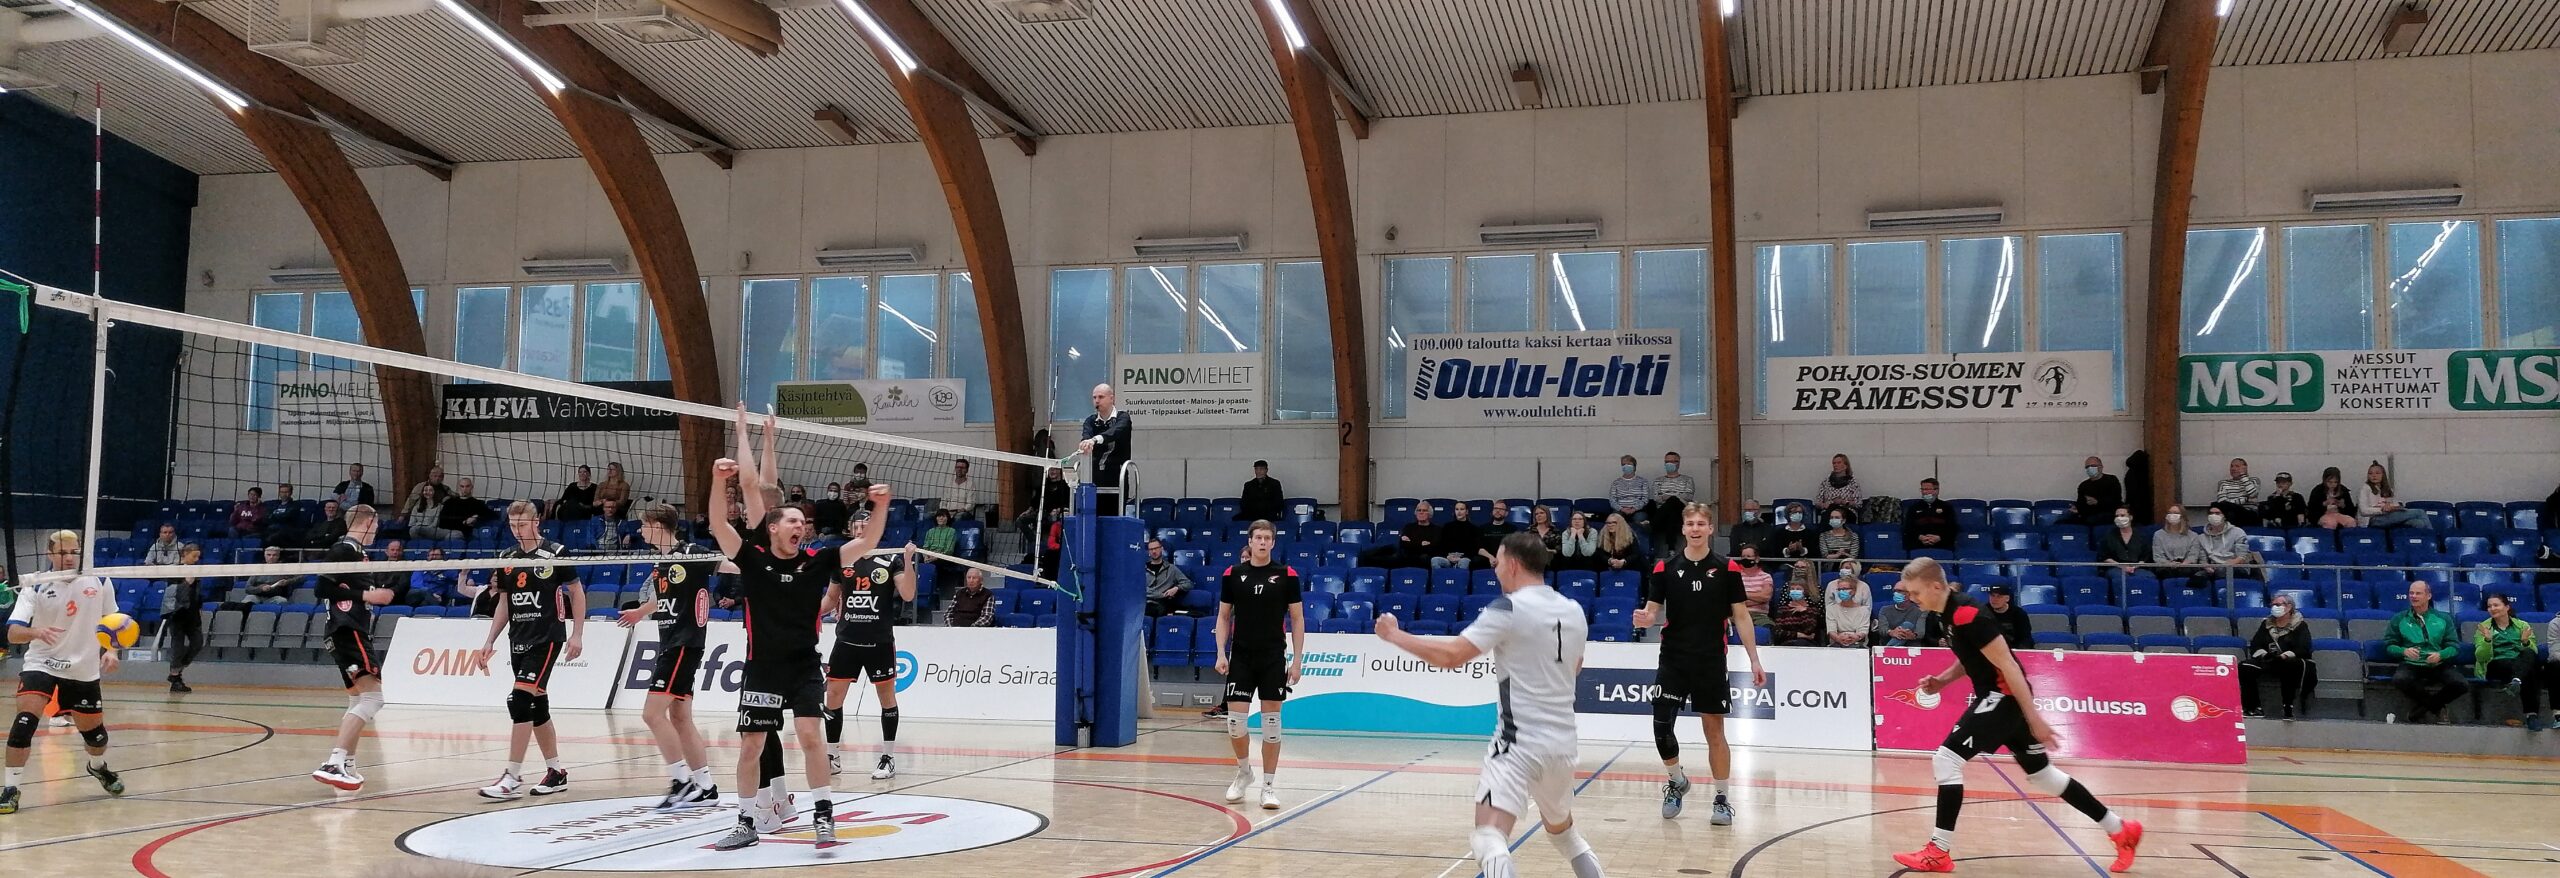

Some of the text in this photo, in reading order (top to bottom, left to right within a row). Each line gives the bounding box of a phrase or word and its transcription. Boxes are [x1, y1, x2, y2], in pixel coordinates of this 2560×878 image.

[1413, 334, 1673, 351] 100.000 taloutta kaksi kertaa viikossa
[2352, 353, 2416, 364] MESSUT
[1123, 366, 1254, 385] PAINOMIEHET
[1413, 356, 1437, 401] UUTIS
[1434, 353, 1672, 400] Oulu-lehti
[1796, 362, 2025, 382] POHJOIS-SUOMEN
[2337, 365, 2433, 379] NÄYTTELYT
[2186, 359, 2313, 407] MSP
[2330, 382, 2440, 395] TAPAHTUMAT
[778, 387, 852, 406] Käsintehtyä
[1218, 398, 1225, 406] ja
[1792, 381, 2023, 411] ERÄMESSUT
[2340, 396, 2430, 409] KONSERTIT
[445, 396, 540, 420] KALEVA
[778, 402, 824, 416] Ruokaa
[1151, 408, 1192, 417] Teippaukset
[1196, 407, 1225, 415] Julisteet
[1229, 407, 1250, 415] Tarrat
[1483, 405, 1597, 418] www.oululehti.fi
[1342, 422, 1352, 446] 2
[516, 571, 528, 588] 8
[856, 576, 871, 591] 13
[1691, 580, 1702, 591] 10
[1254, 584, 1264, 595] 17
[66, 600, 77, 617] 3
[846, 596, 879, 612] eezy
[1552, 619, 1563, 664] 1
[1882, 657, 1912, 666] OULU
[924, 663, 992, 688] Pohjola
[1226, 682, 1236, 697] 17
[1598, 683, 1774, 707] LASKPPA
[1780, 689, 1847, 709] .COM
[740, 710, 751, 726] 16
